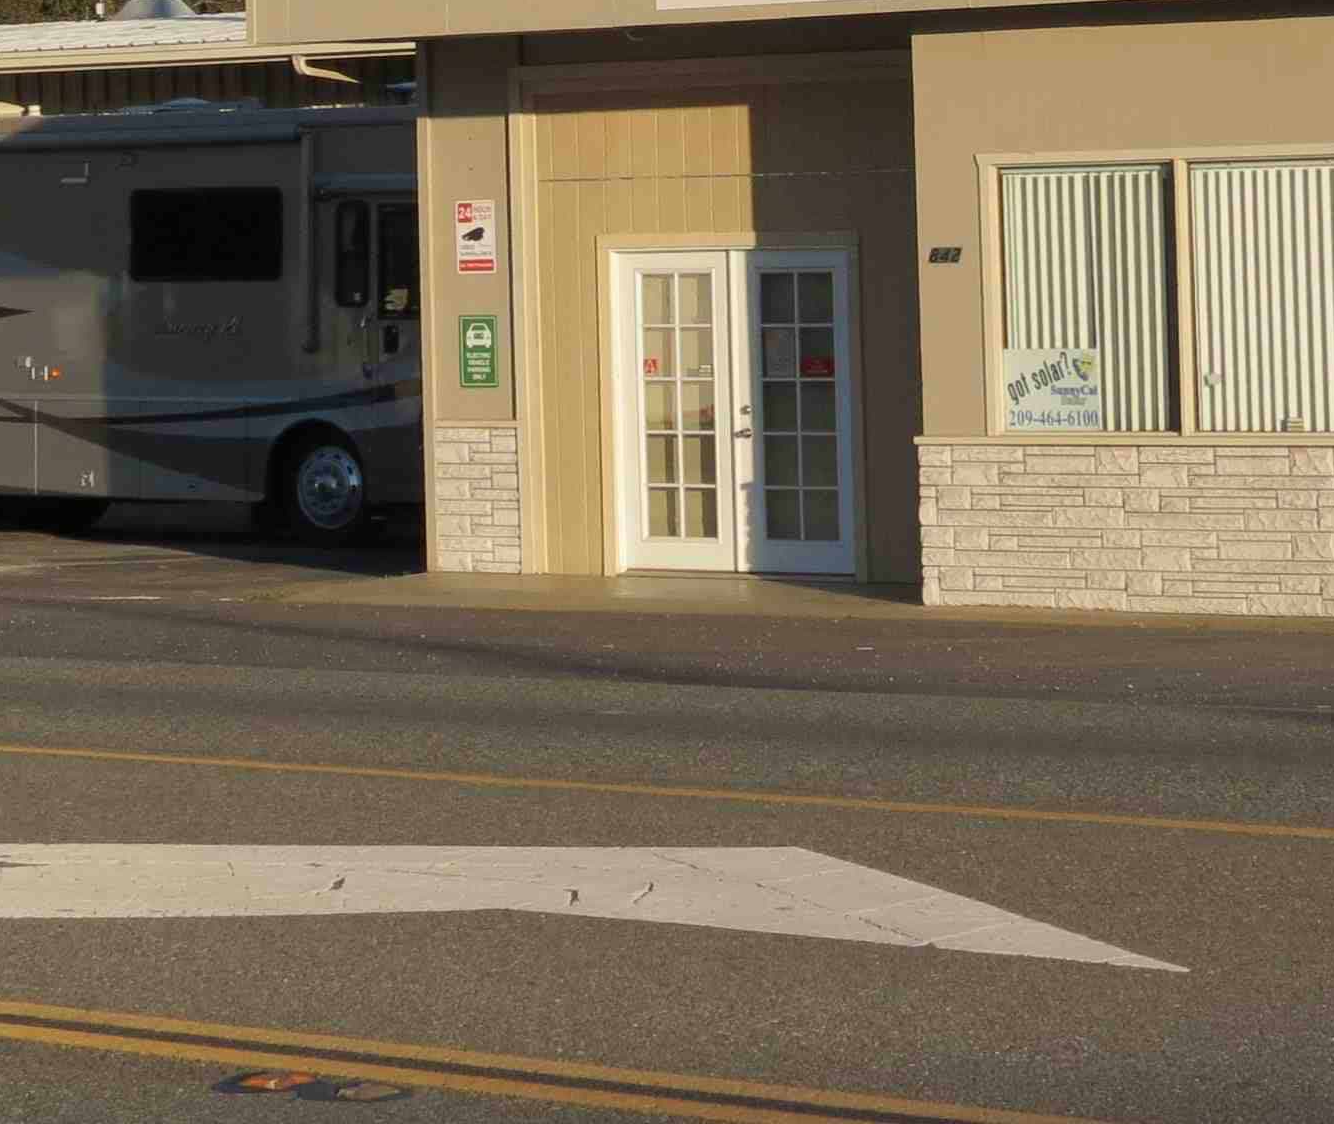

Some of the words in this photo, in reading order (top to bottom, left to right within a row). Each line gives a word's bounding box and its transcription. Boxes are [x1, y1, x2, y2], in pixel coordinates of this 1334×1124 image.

[1007, 372, 1030, 406] got
[1031, 351, 1072, 391] solar?
[1051, 384, 1099, 397] SunnyCal
[1009, 410, 1099, 426] 209-464-6100
